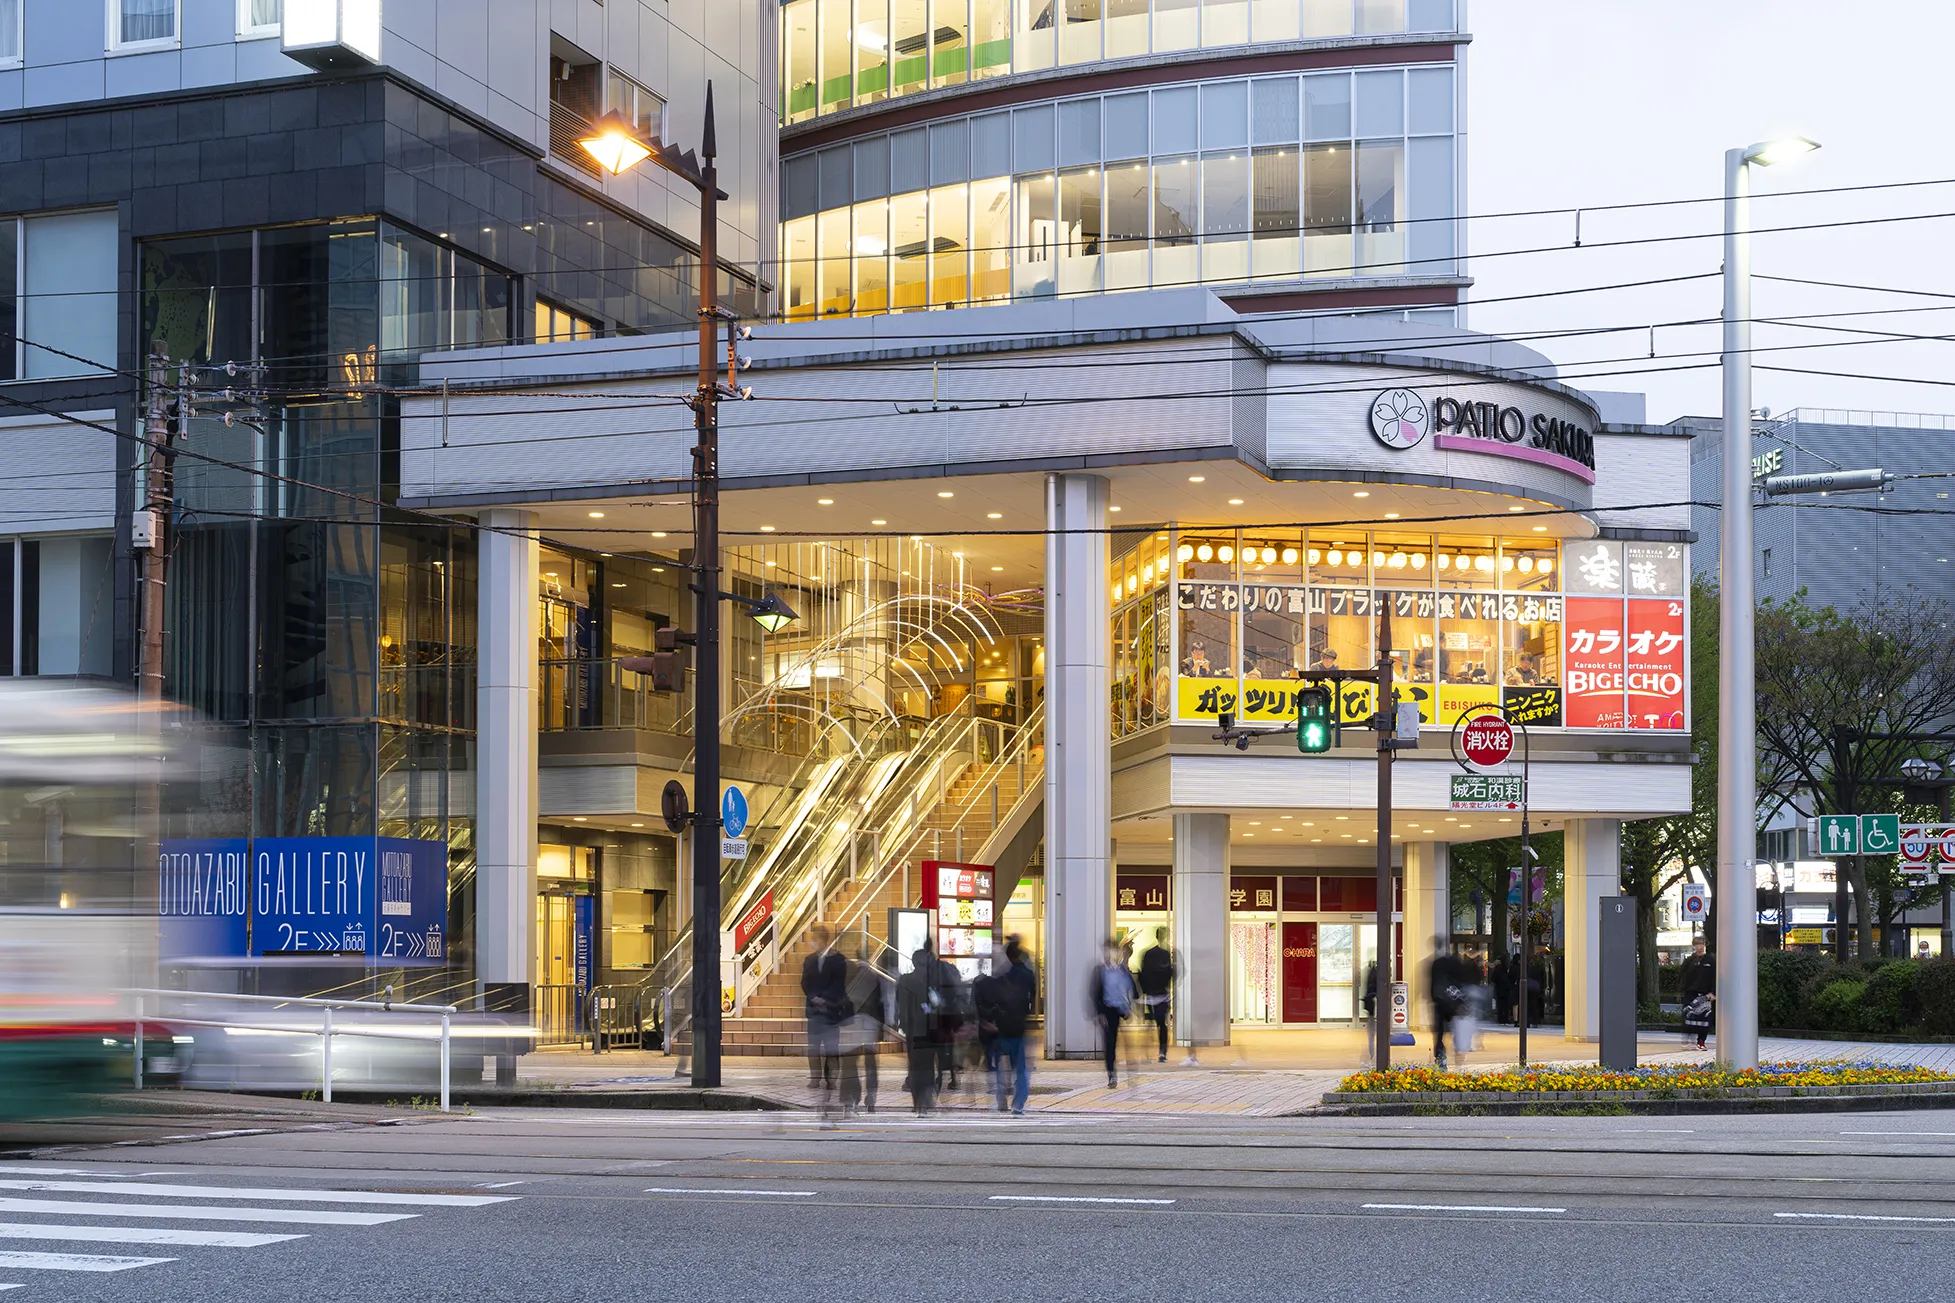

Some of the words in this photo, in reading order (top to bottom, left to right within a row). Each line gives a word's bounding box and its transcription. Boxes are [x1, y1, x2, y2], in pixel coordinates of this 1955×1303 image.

[1437, 396, 1526, 442] PATIO
[1533, 413, 1596, 471] SAKURA
[1667, 546, 1681, 559] 2F
[1668, 602, 1683, 617] 2F
[1569, 629, 1683, 656] カラオケ
[1575, 661, 1606, 671] Karaoke
[1608, 662, 1672, 671] Entertainment
[1444, 700, 1493, 710] EBISUKO
[1506, 690, 1555, 709] ニンニク
[1466, 730, 1510, 751] 消火栓
[1453, 783, 1521, 797] 城石内科
[258, 851, 366, 915] GALLERY
[382, 876, 412, 902] GALLERY
[1119, 888, 1163, 906] 富山
[1230, 889, 1273, 907] 学園
[278, 922, 309, 950] 2F
[381, 922, 404, 957] 2F
